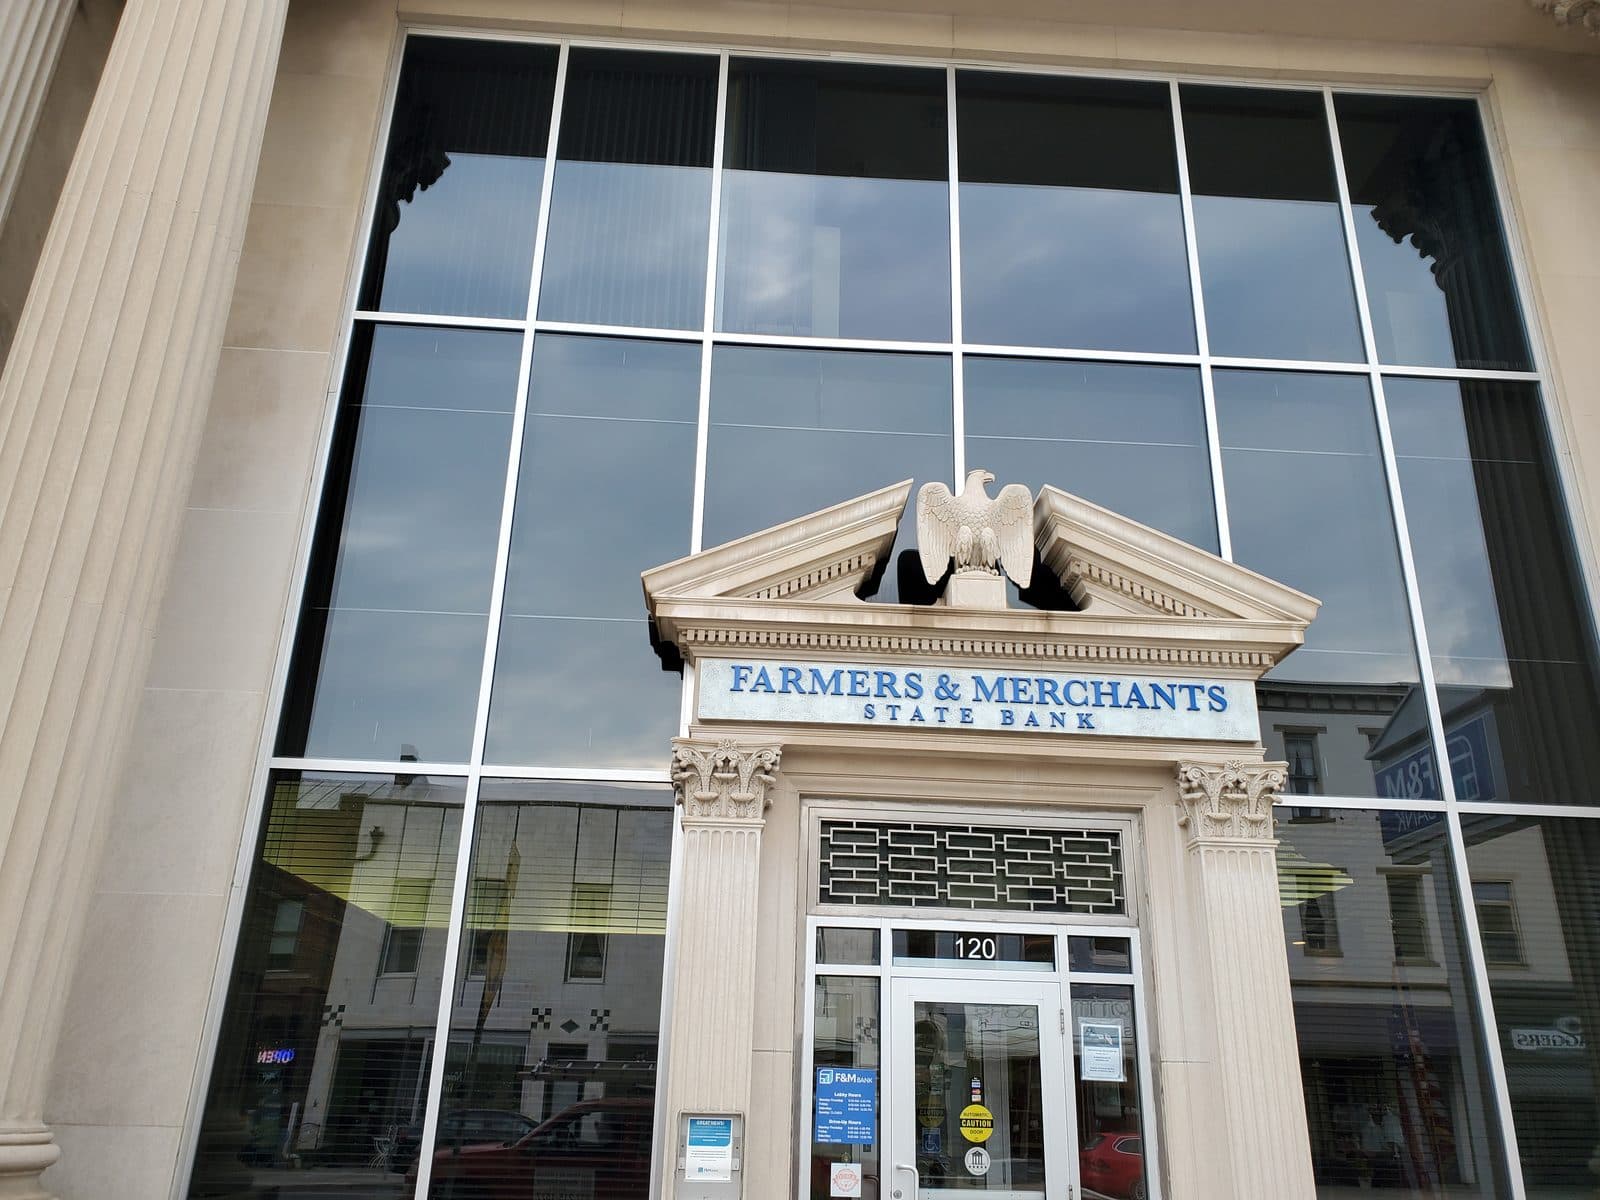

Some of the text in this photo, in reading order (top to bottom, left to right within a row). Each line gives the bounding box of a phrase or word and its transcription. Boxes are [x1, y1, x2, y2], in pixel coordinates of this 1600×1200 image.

[729, 665, 1229, 713] FARMERS & MERCHANTS
[863, 703, 1096, 729] STATE BANK
[955, 937, 996, 959] 120
[835, 1072, 856, 1083] F&M
[961, 1119, 992, 1127] CAUTION
